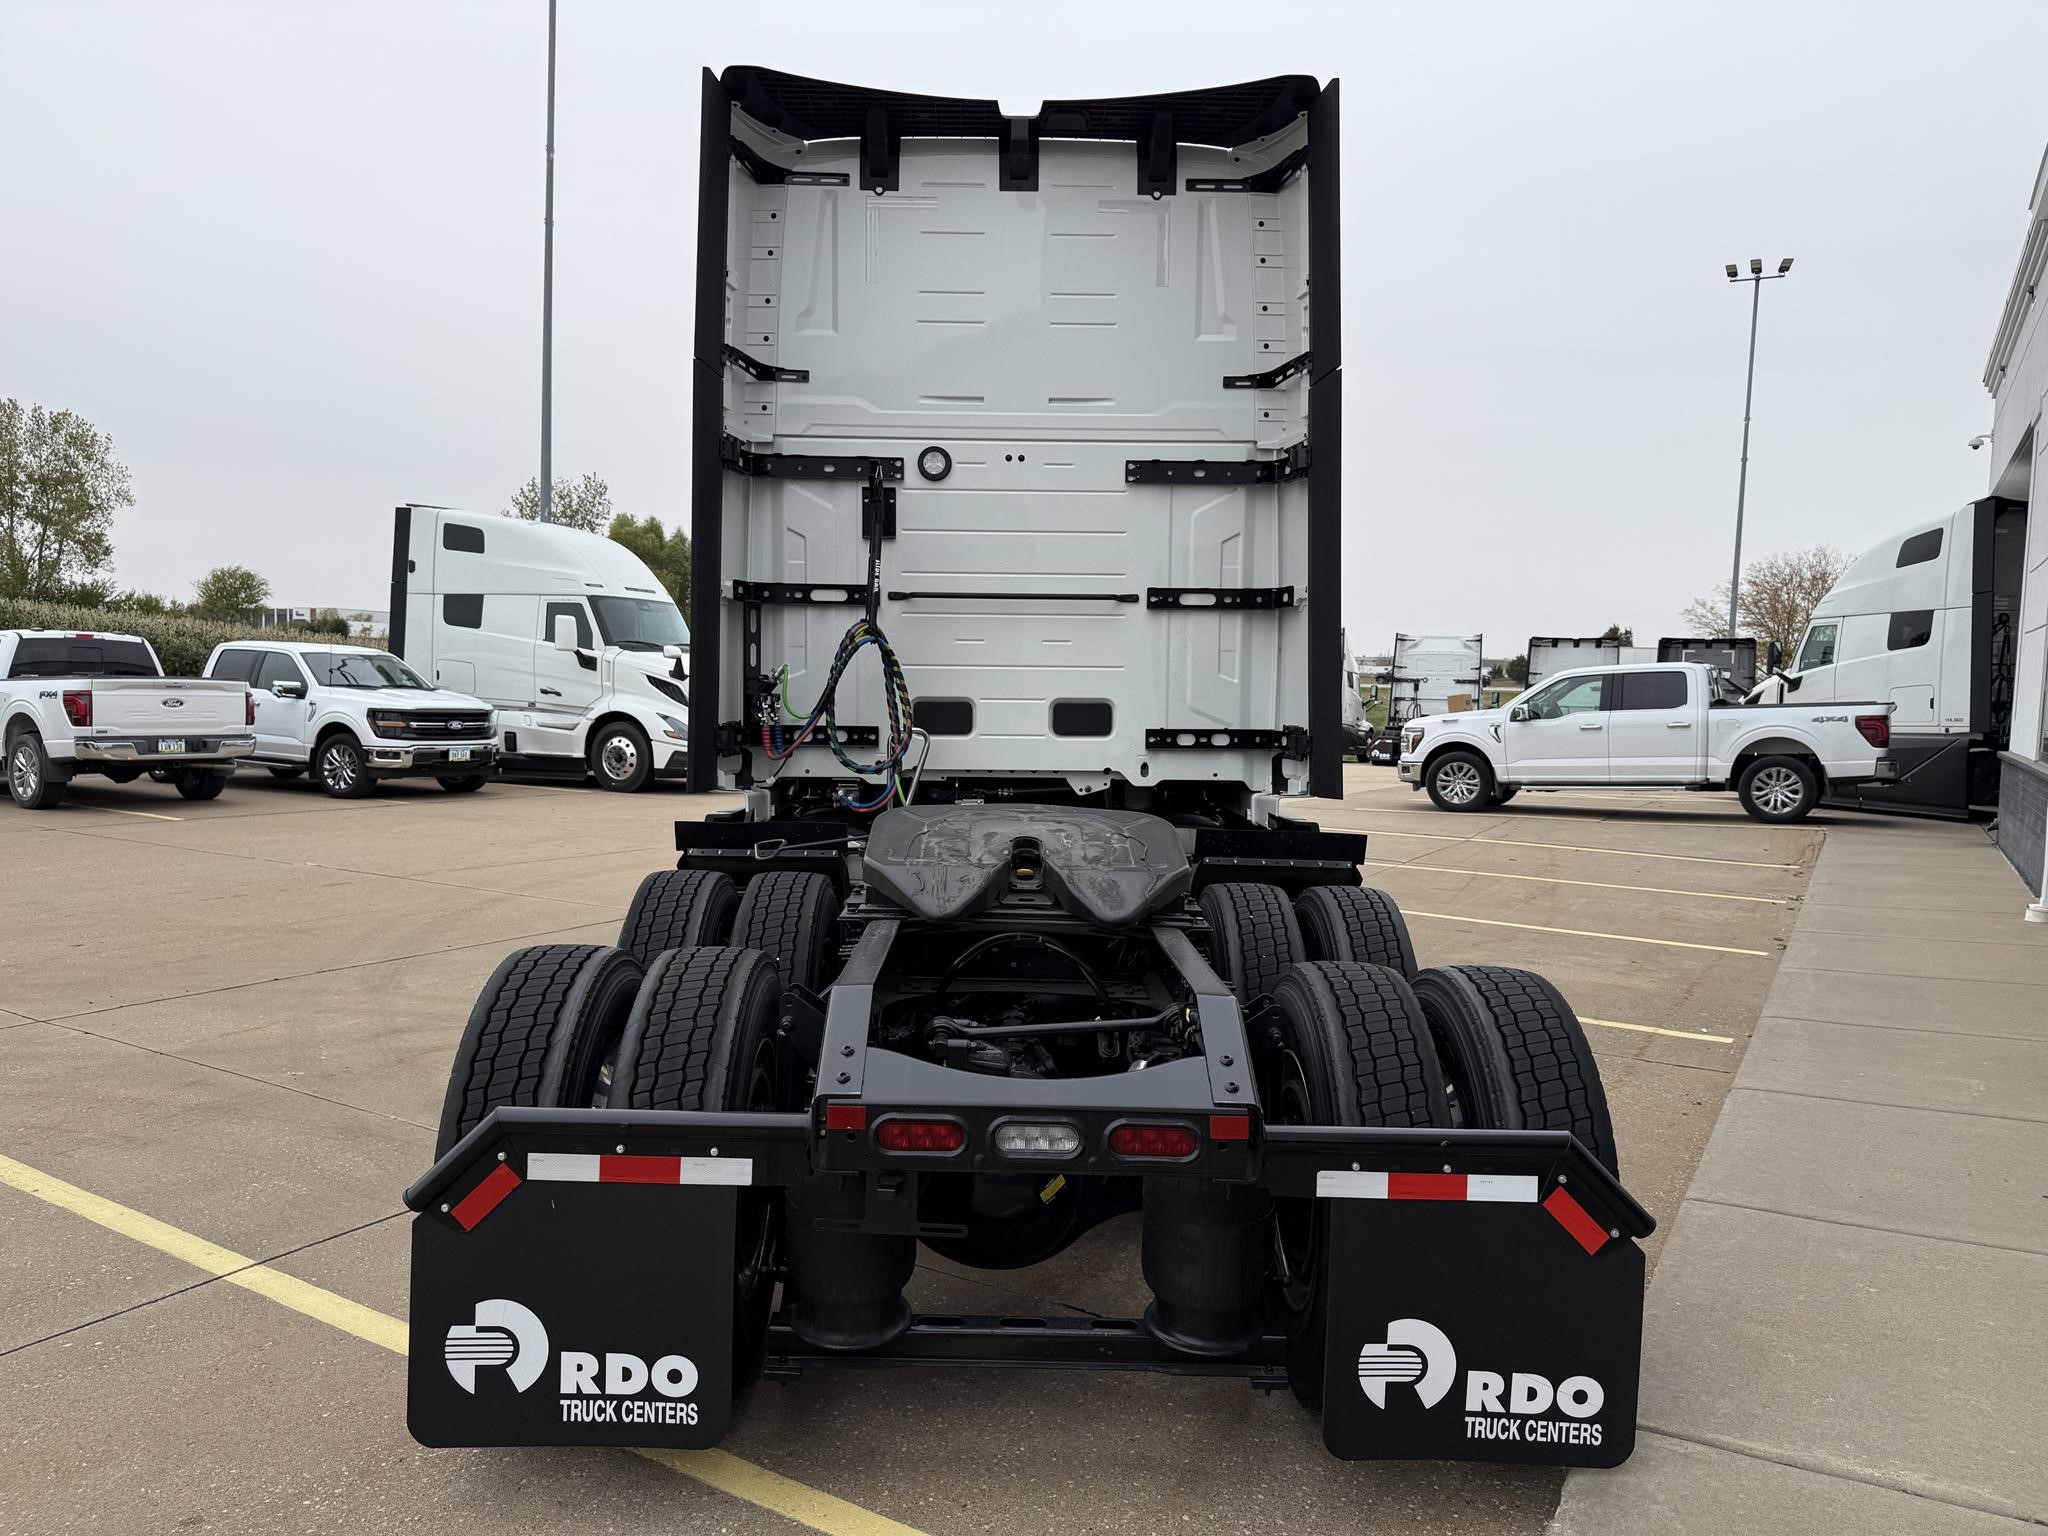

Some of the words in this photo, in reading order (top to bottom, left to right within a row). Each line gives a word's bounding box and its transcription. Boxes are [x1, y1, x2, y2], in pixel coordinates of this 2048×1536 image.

[39, 691, 58, 699] FX4
[560, 1351, 699, 1398] RDO
[1465, 1370, 1605, 1418] RDO
[559, 1399, 618, 1423] TRUCK
[621, 1400, 699, 1426] CENTERS
[1464, 1416, 1521, 1441] TRUCK
[1525, 1419, 1603, 1446] CENTERS
